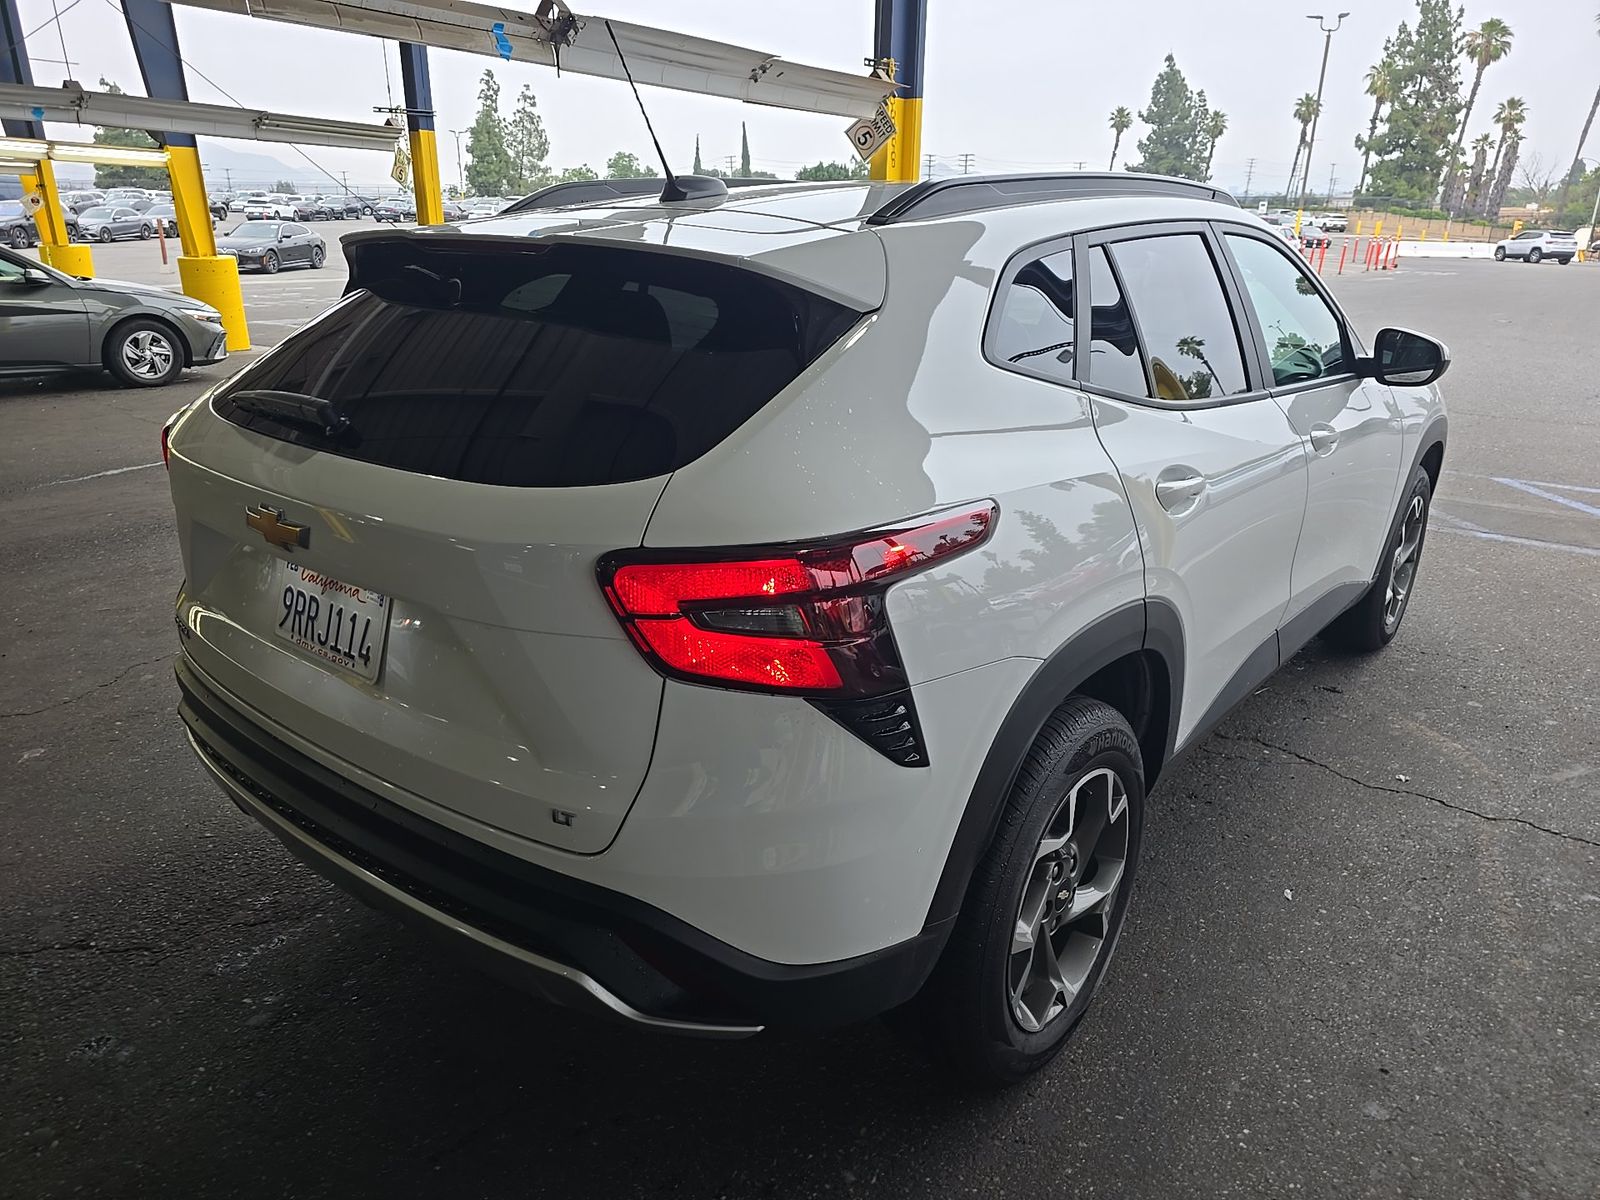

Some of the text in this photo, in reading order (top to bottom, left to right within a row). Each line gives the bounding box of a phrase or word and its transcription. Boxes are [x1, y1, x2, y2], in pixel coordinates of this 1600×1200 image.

[857, 131, 873, 146] 5
[278, 584, 372, 667] 9RRJ114
[295, 637, 350, 667] dmv.ca.gov
[552, 808, 577, 827] LT
